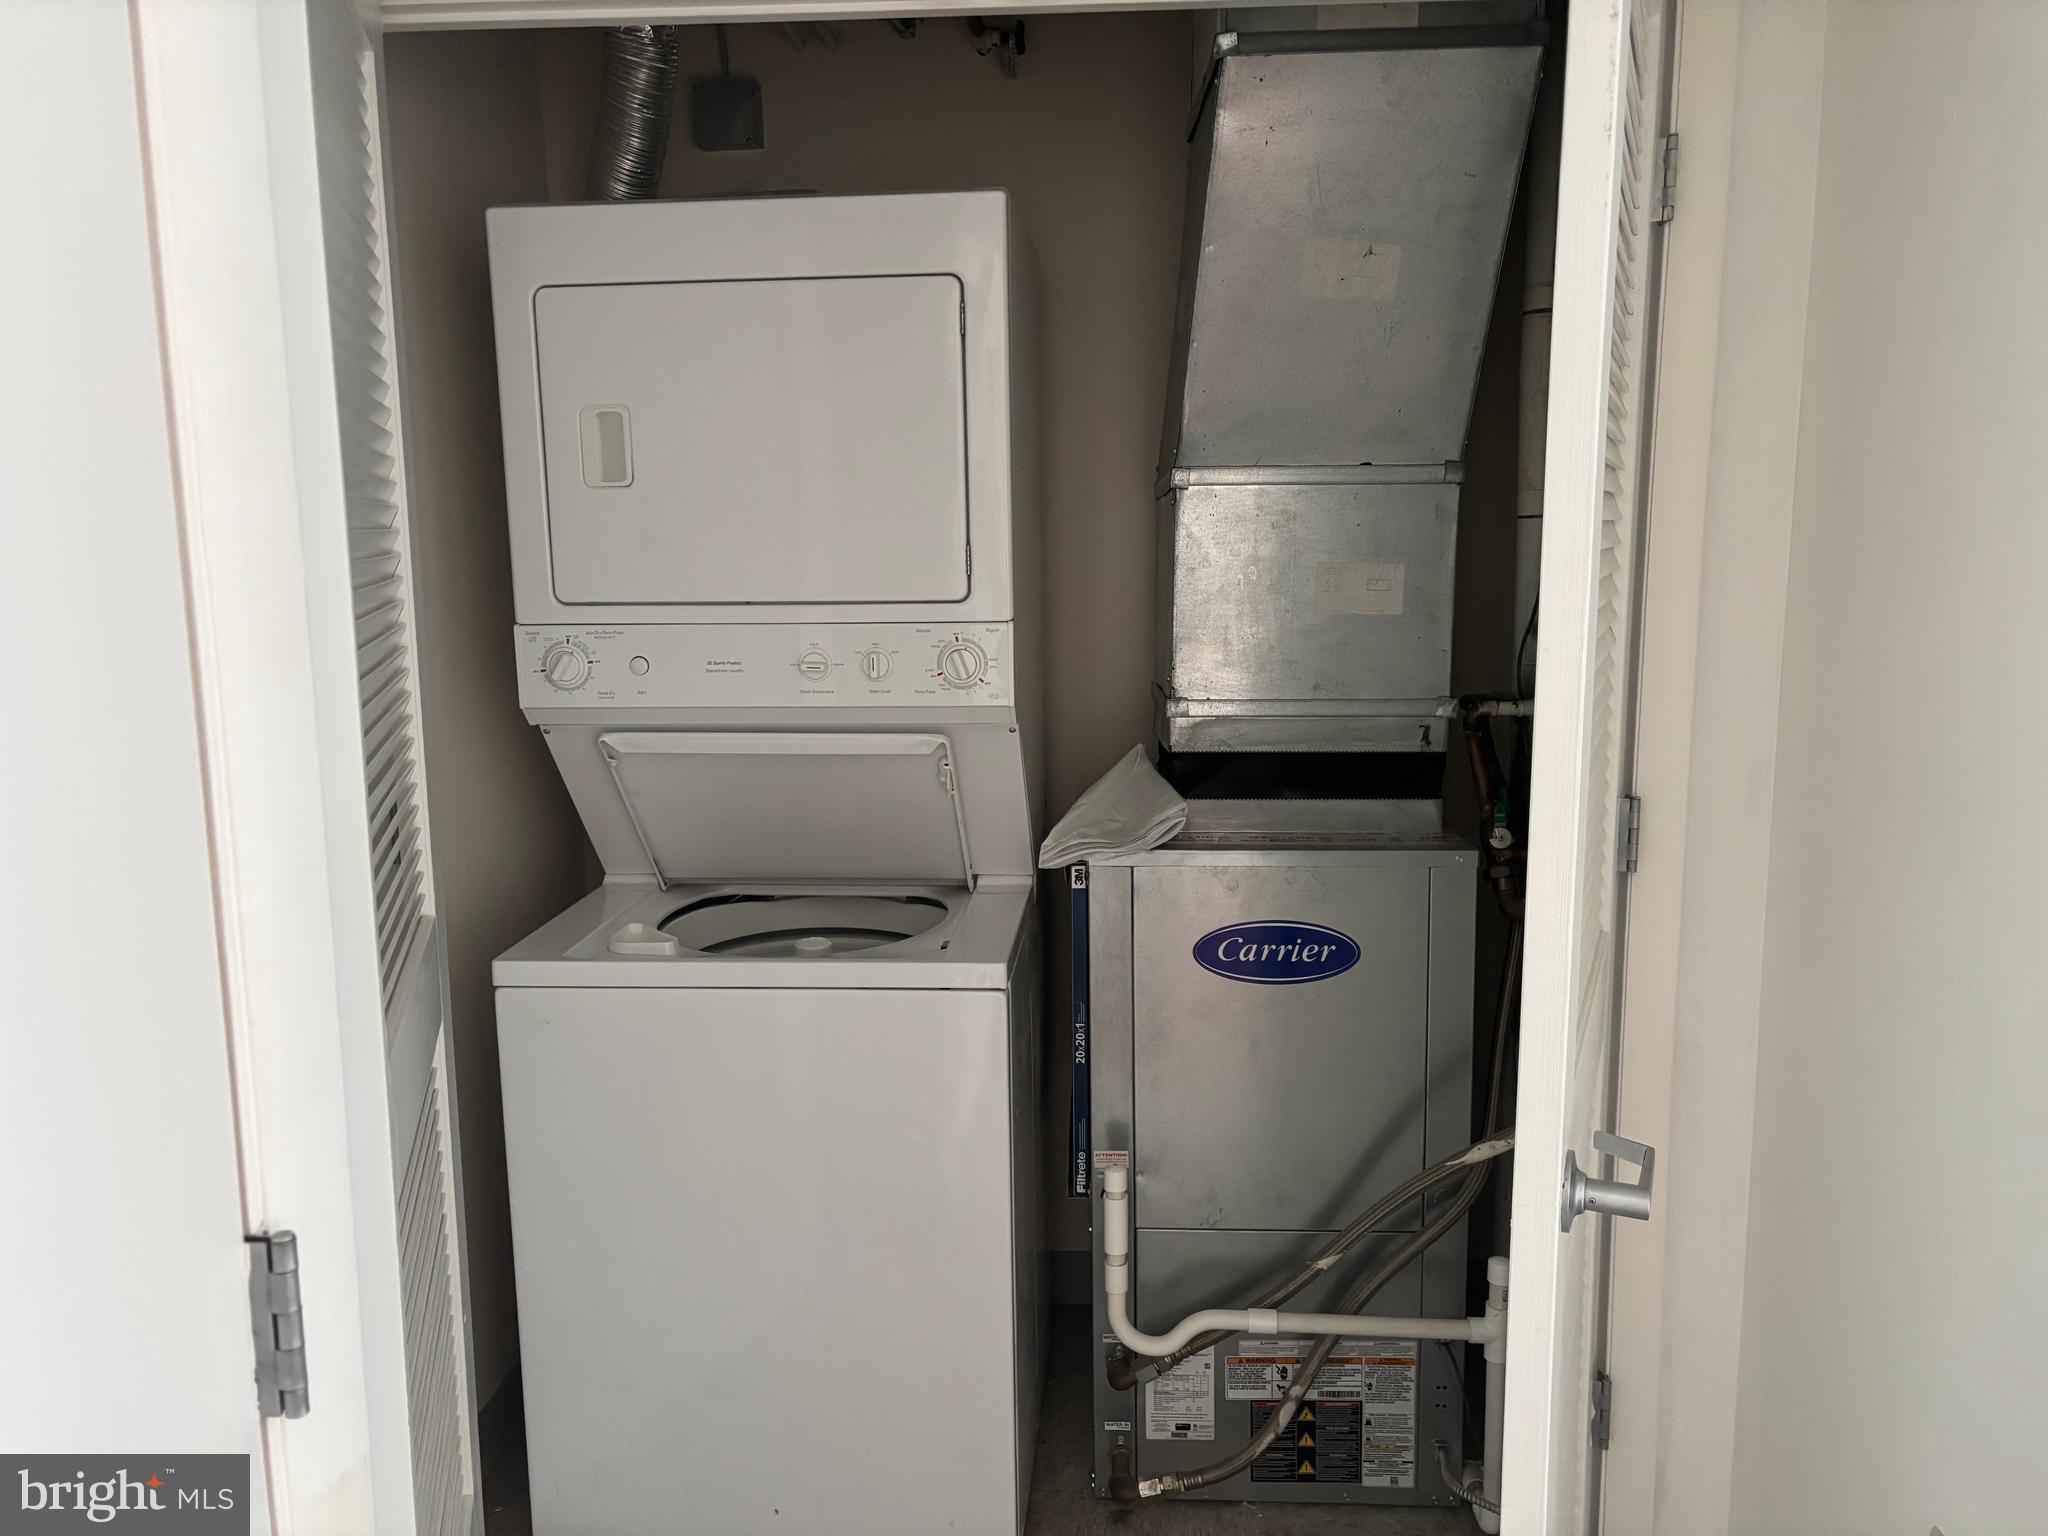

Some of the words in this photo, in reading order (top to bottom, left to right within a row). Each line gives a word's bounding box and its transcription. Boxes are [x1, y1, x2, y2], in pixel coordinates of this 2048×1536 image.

[1074, 868, 1084, 886] 3M
[1217, 937, 1337, 963] Carrier
[1075, 1023, 1086, 1065] 20x20x1
[1076, 1151, 1086, 1194] Filtrete
